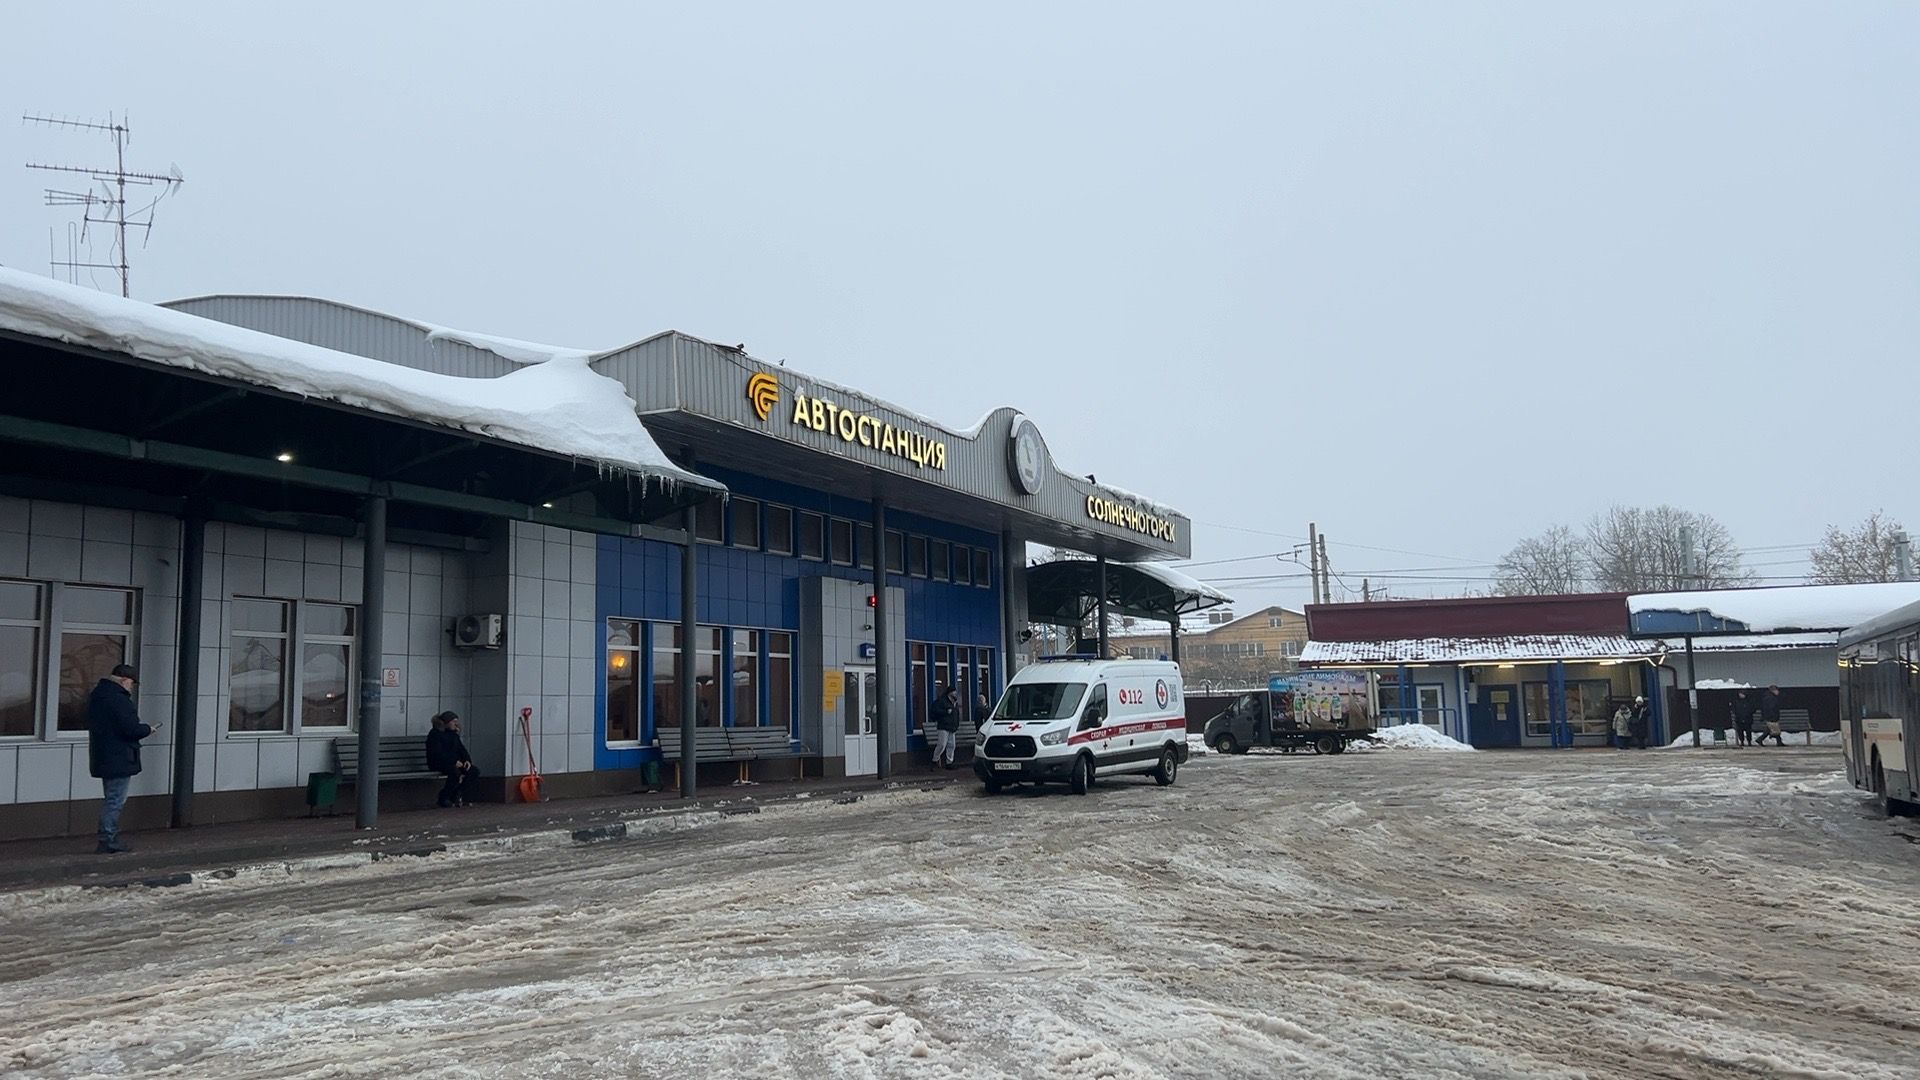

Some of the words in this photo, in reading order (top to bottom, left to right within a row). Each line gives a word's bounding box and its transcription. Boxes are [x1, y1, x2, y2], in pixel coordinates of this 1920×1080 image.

[793, 394, 946, 470] АВТОСТАНЦИЯ
[1087, 495, 1175, 543] СОЛНЕЧНОГОРСК
[1128, 689, 1143, 704] 112
[1091, 729, 1107, 739] СКОРАЯ
